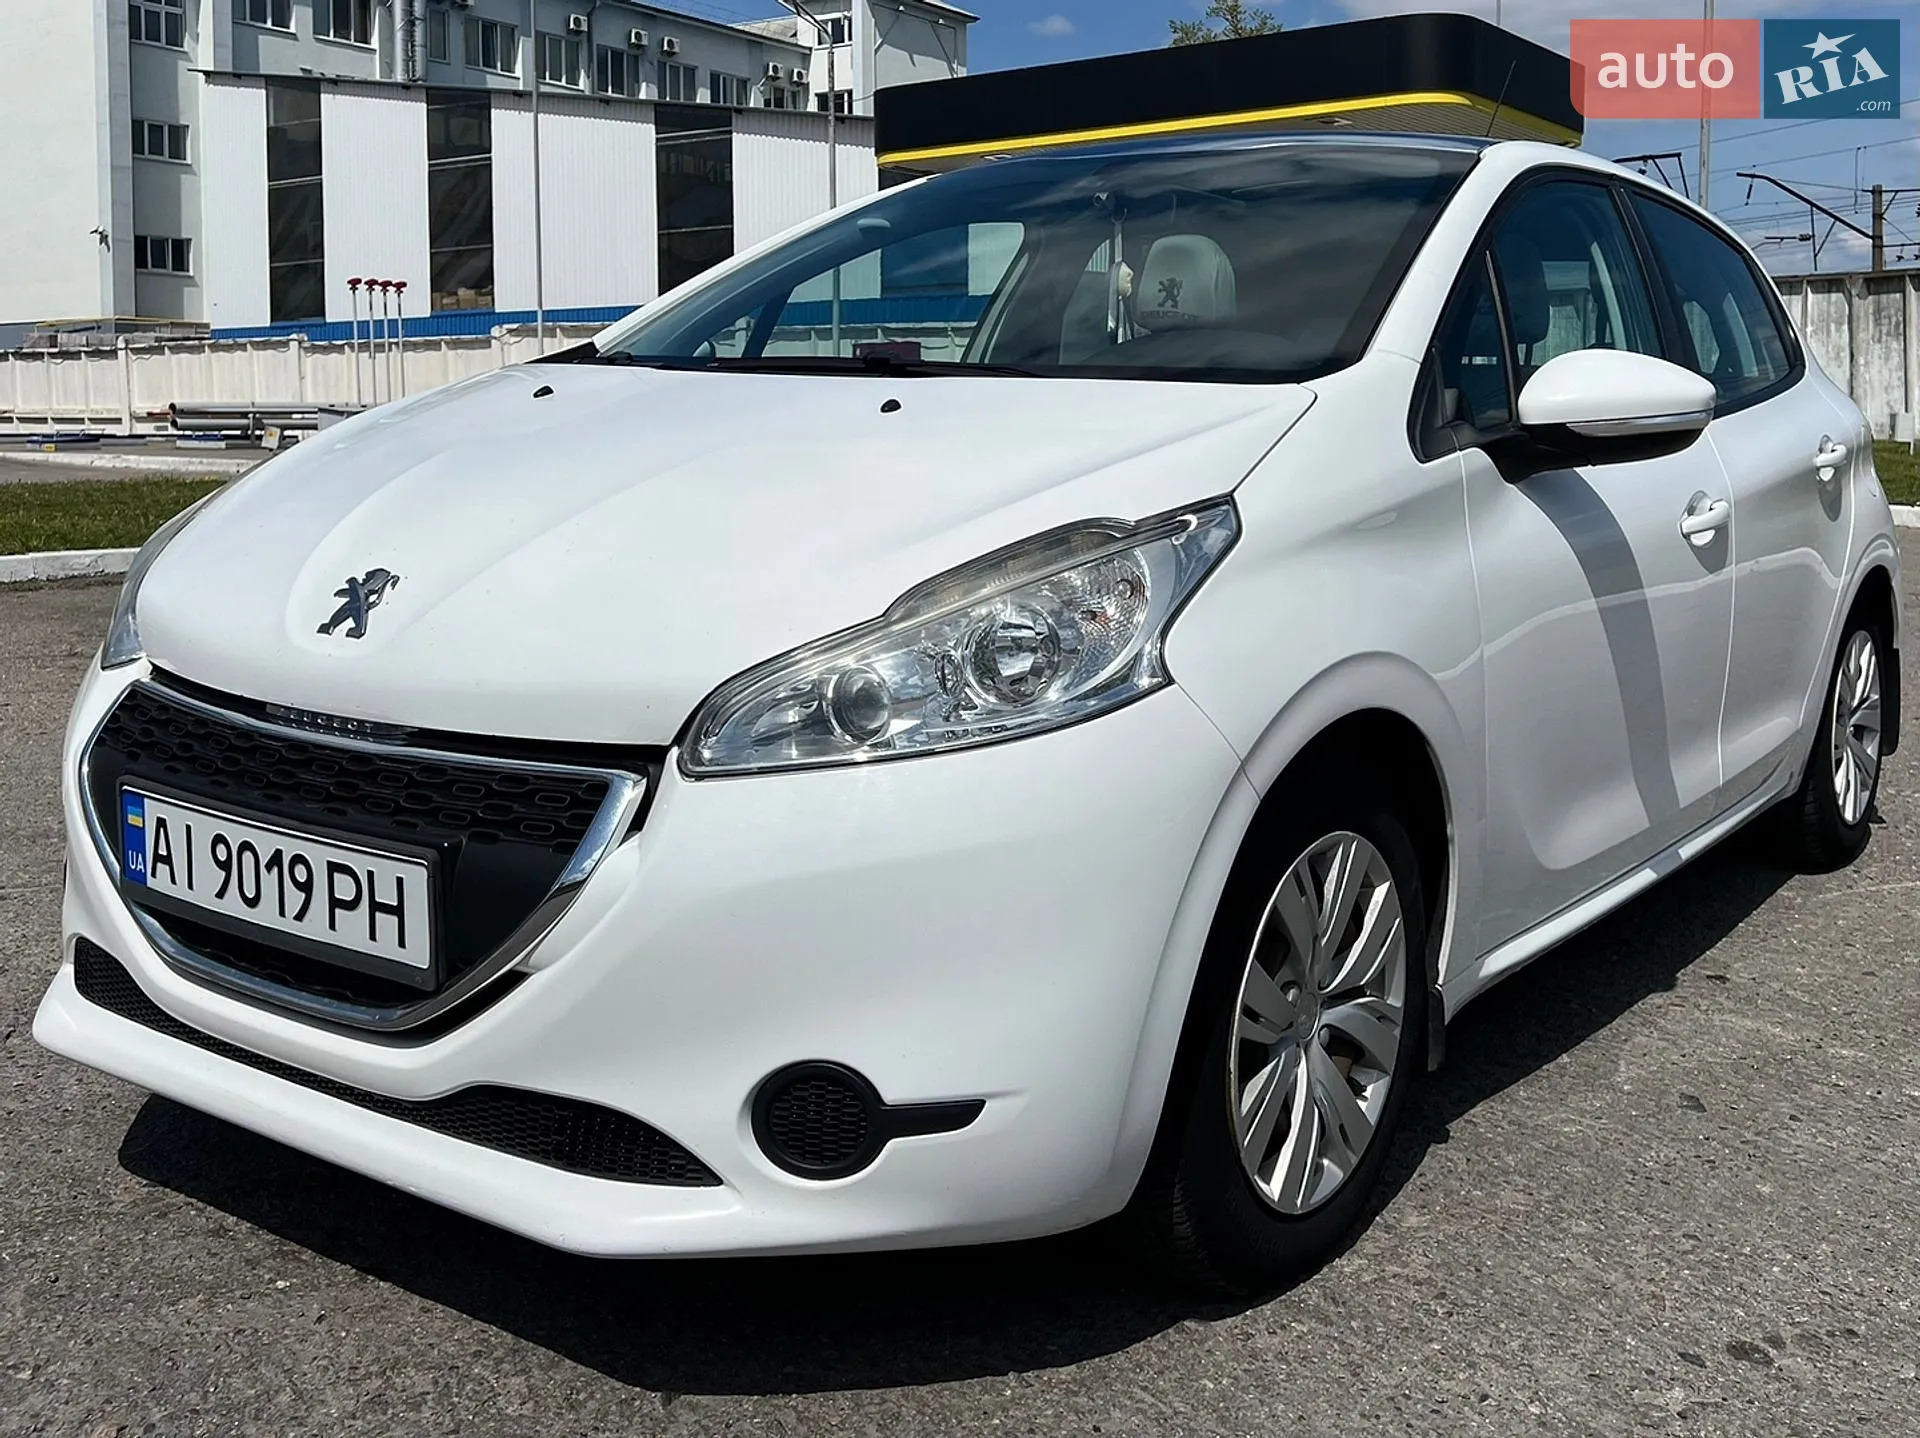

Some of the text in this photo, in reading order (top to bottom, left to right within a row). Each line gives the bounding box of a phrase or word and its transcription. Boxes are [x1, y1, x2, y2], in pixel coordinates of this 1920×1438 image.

[128, 850, 145, 873] UA
[150, 815, 406, 949] AI 9019 PH
